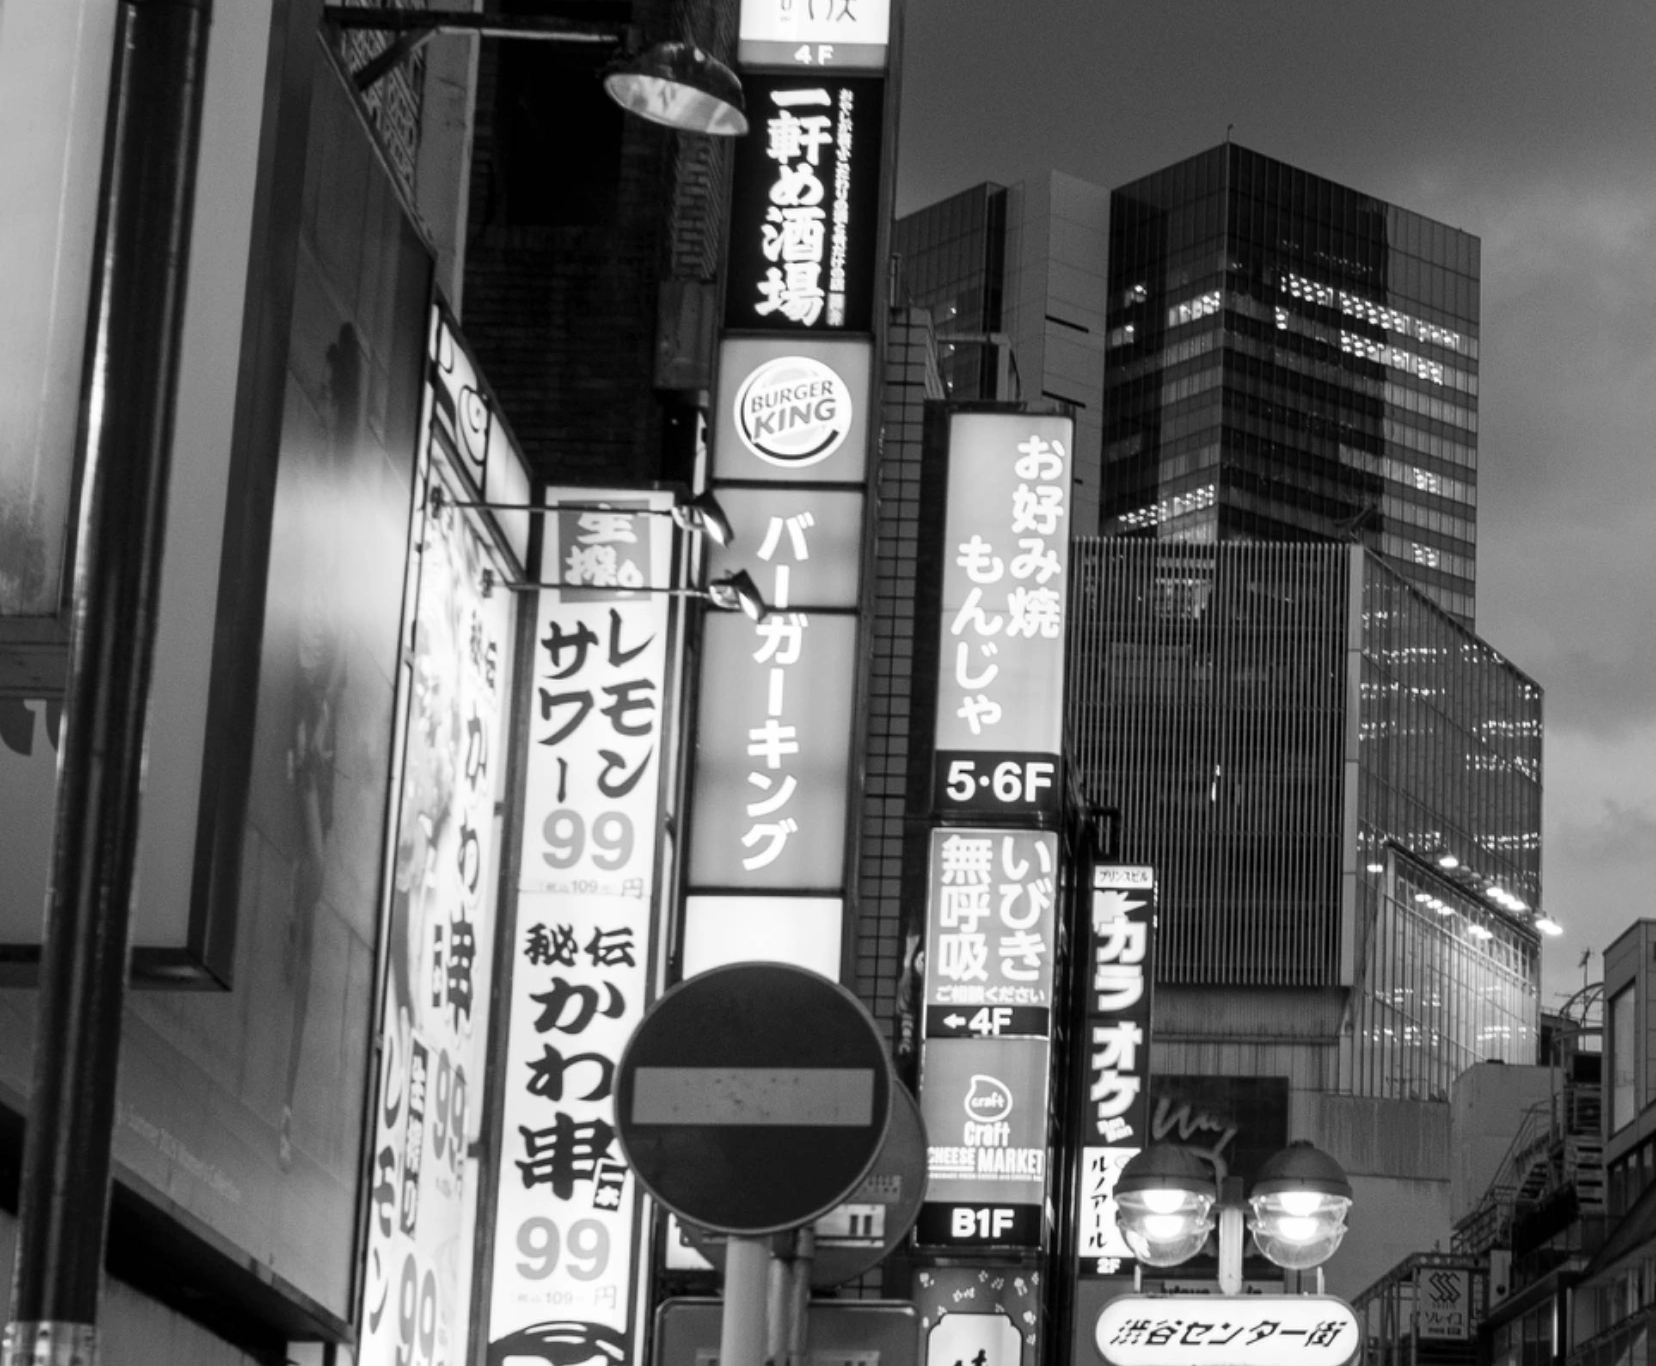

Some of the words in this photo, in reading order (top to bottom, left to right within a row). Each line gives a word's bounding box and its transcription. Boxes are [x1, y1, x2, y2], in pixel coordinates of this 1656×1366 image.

[794, 45, 834, 64] 4F
[754, 87, 833, 327] 一軒め酒場
[751, 379, 834, 415] BURGER
[753, 397, 837, 440] KING
[1006, 434, 1065, 638] お好み焼
[951, 534, 1005, 736] もんじゃ
[538, 618, 601, 802] サワー
[596, 608, 657, 799] レモン
[741, 512, 815, 871] バーガーキング
[541, 808, 635, 871] 99
[621, 877, 644, 899] 円
[524, 922, 638, 970] 秘伝
[937, 835, 993, 981] 無呼吸
[998, 836, 1053, 981] いびき
[969, 1009, 1014, 1036] 4F
[1090, 916, 1147, 1118] カラオケ
[515, 976, 627, 1200] かわ串
[963, 1119, 1011, 1147] Craft
[977, 1147, 1045, 1174] MARKET
[1088, 1154, 1110, 1251] ルノアール
[514, 1215, 611, 1282] 99
[951, 1208, 1015, 1237] B1F
[1109, 1318, 1348, 1349] 渋谷センター街
